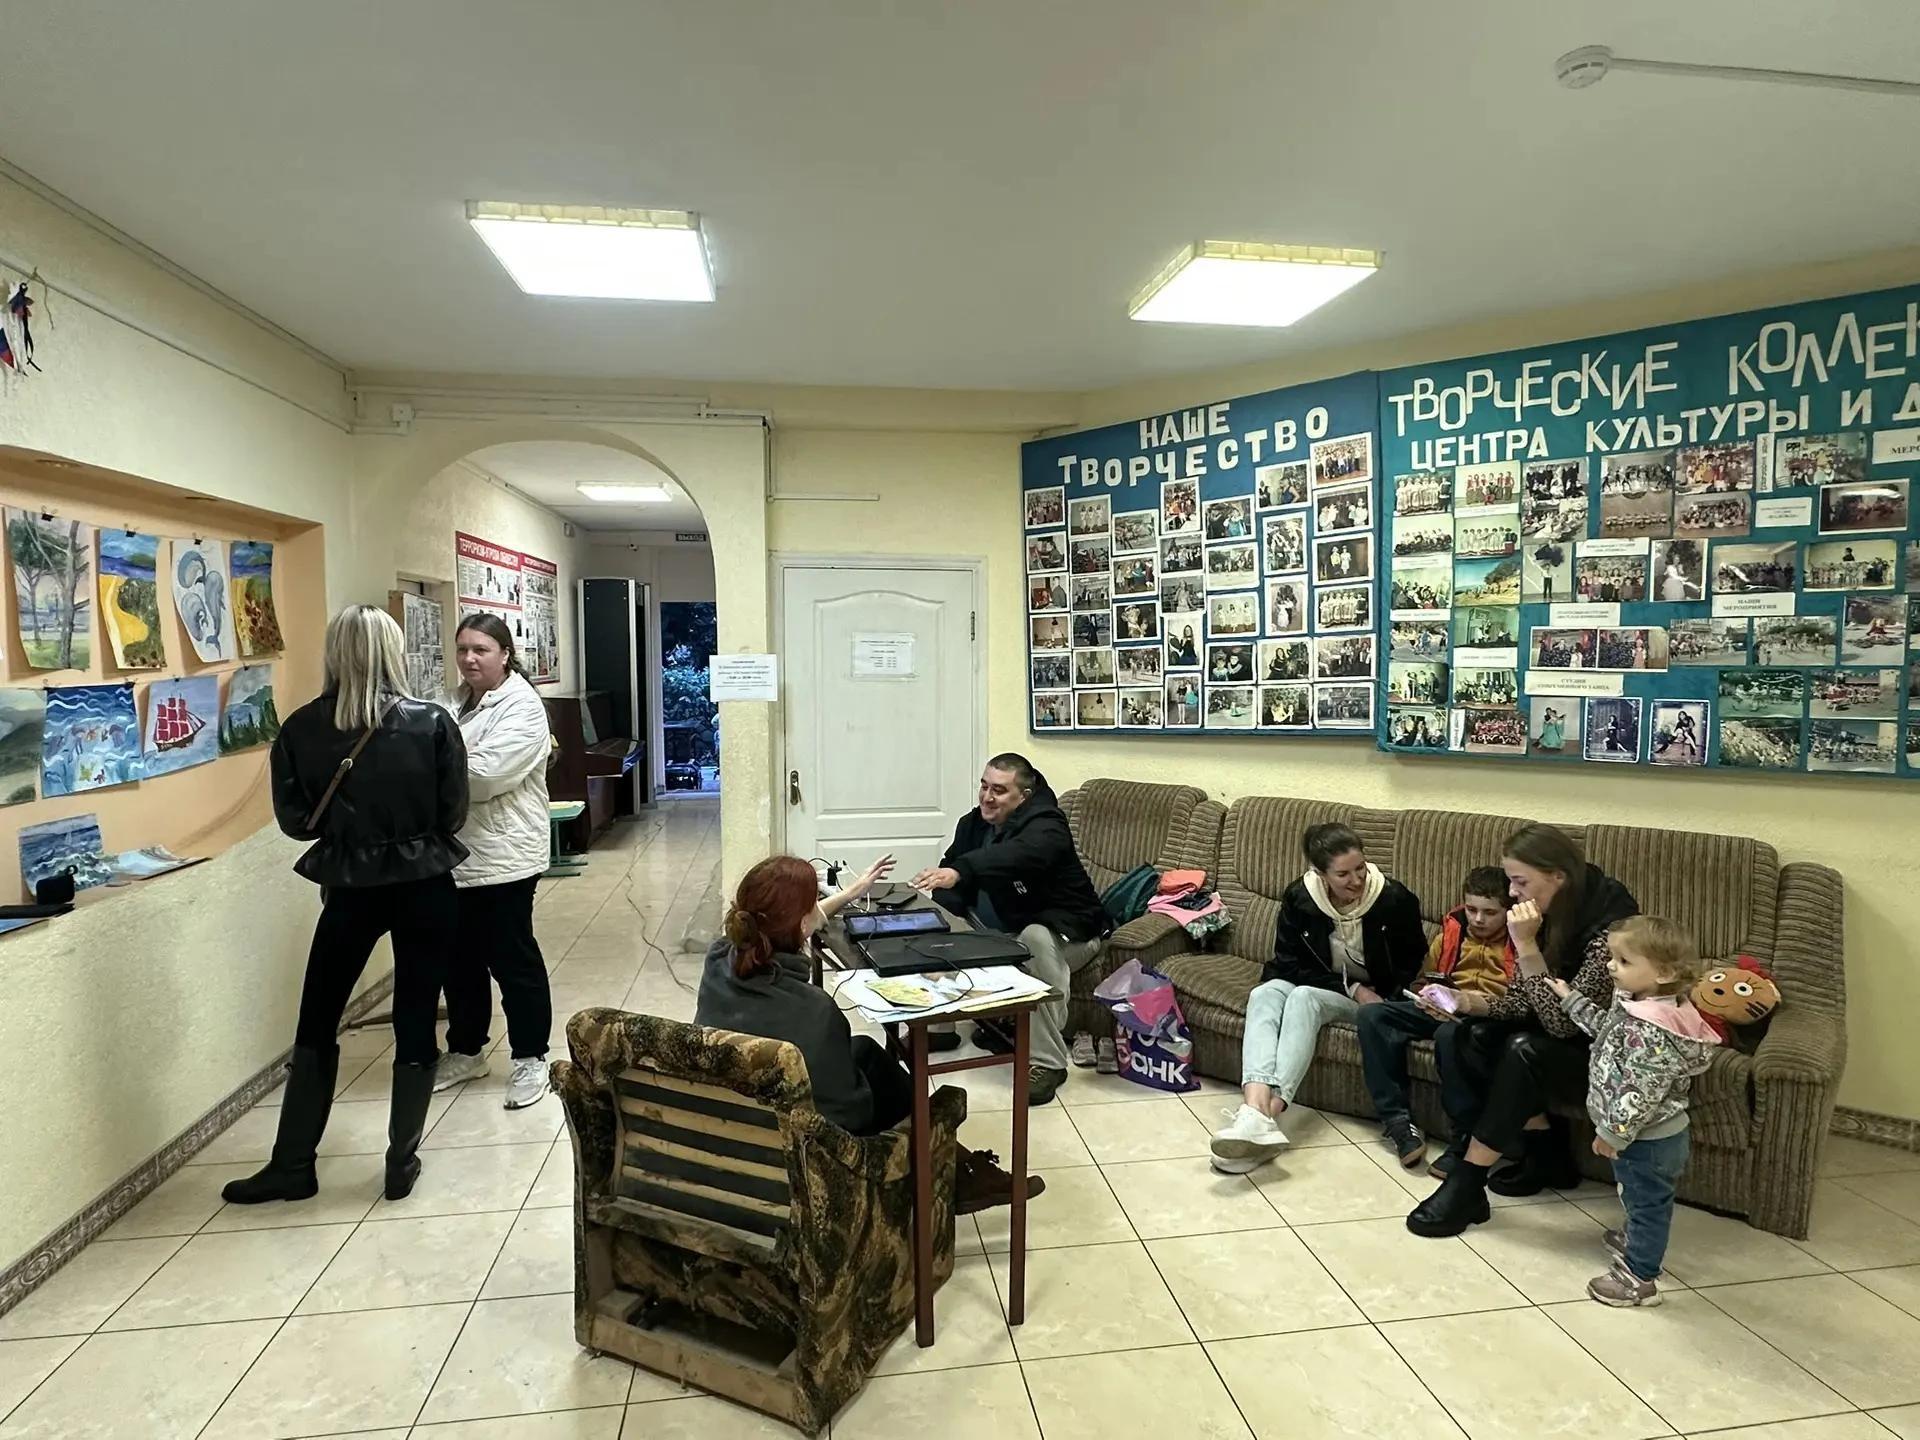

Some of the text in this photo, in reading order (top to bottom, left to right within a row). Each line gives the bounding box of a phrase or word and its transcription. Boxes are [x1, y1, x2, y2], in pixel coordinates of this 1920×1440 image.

[1139, 402, 1231, 450] НАШЕ
[1388, 342, 1679, 437] ТВОРЧЕСКИЕ
[1411, 426, 1550, 473] ЦЕНТРА
[1585, 395, 1810, 453] КУЛЬТУРЫ
[1840, 388, 1873, 427] И
[1057, 406, 1330, 488] ТВОРЧЕСТВО
